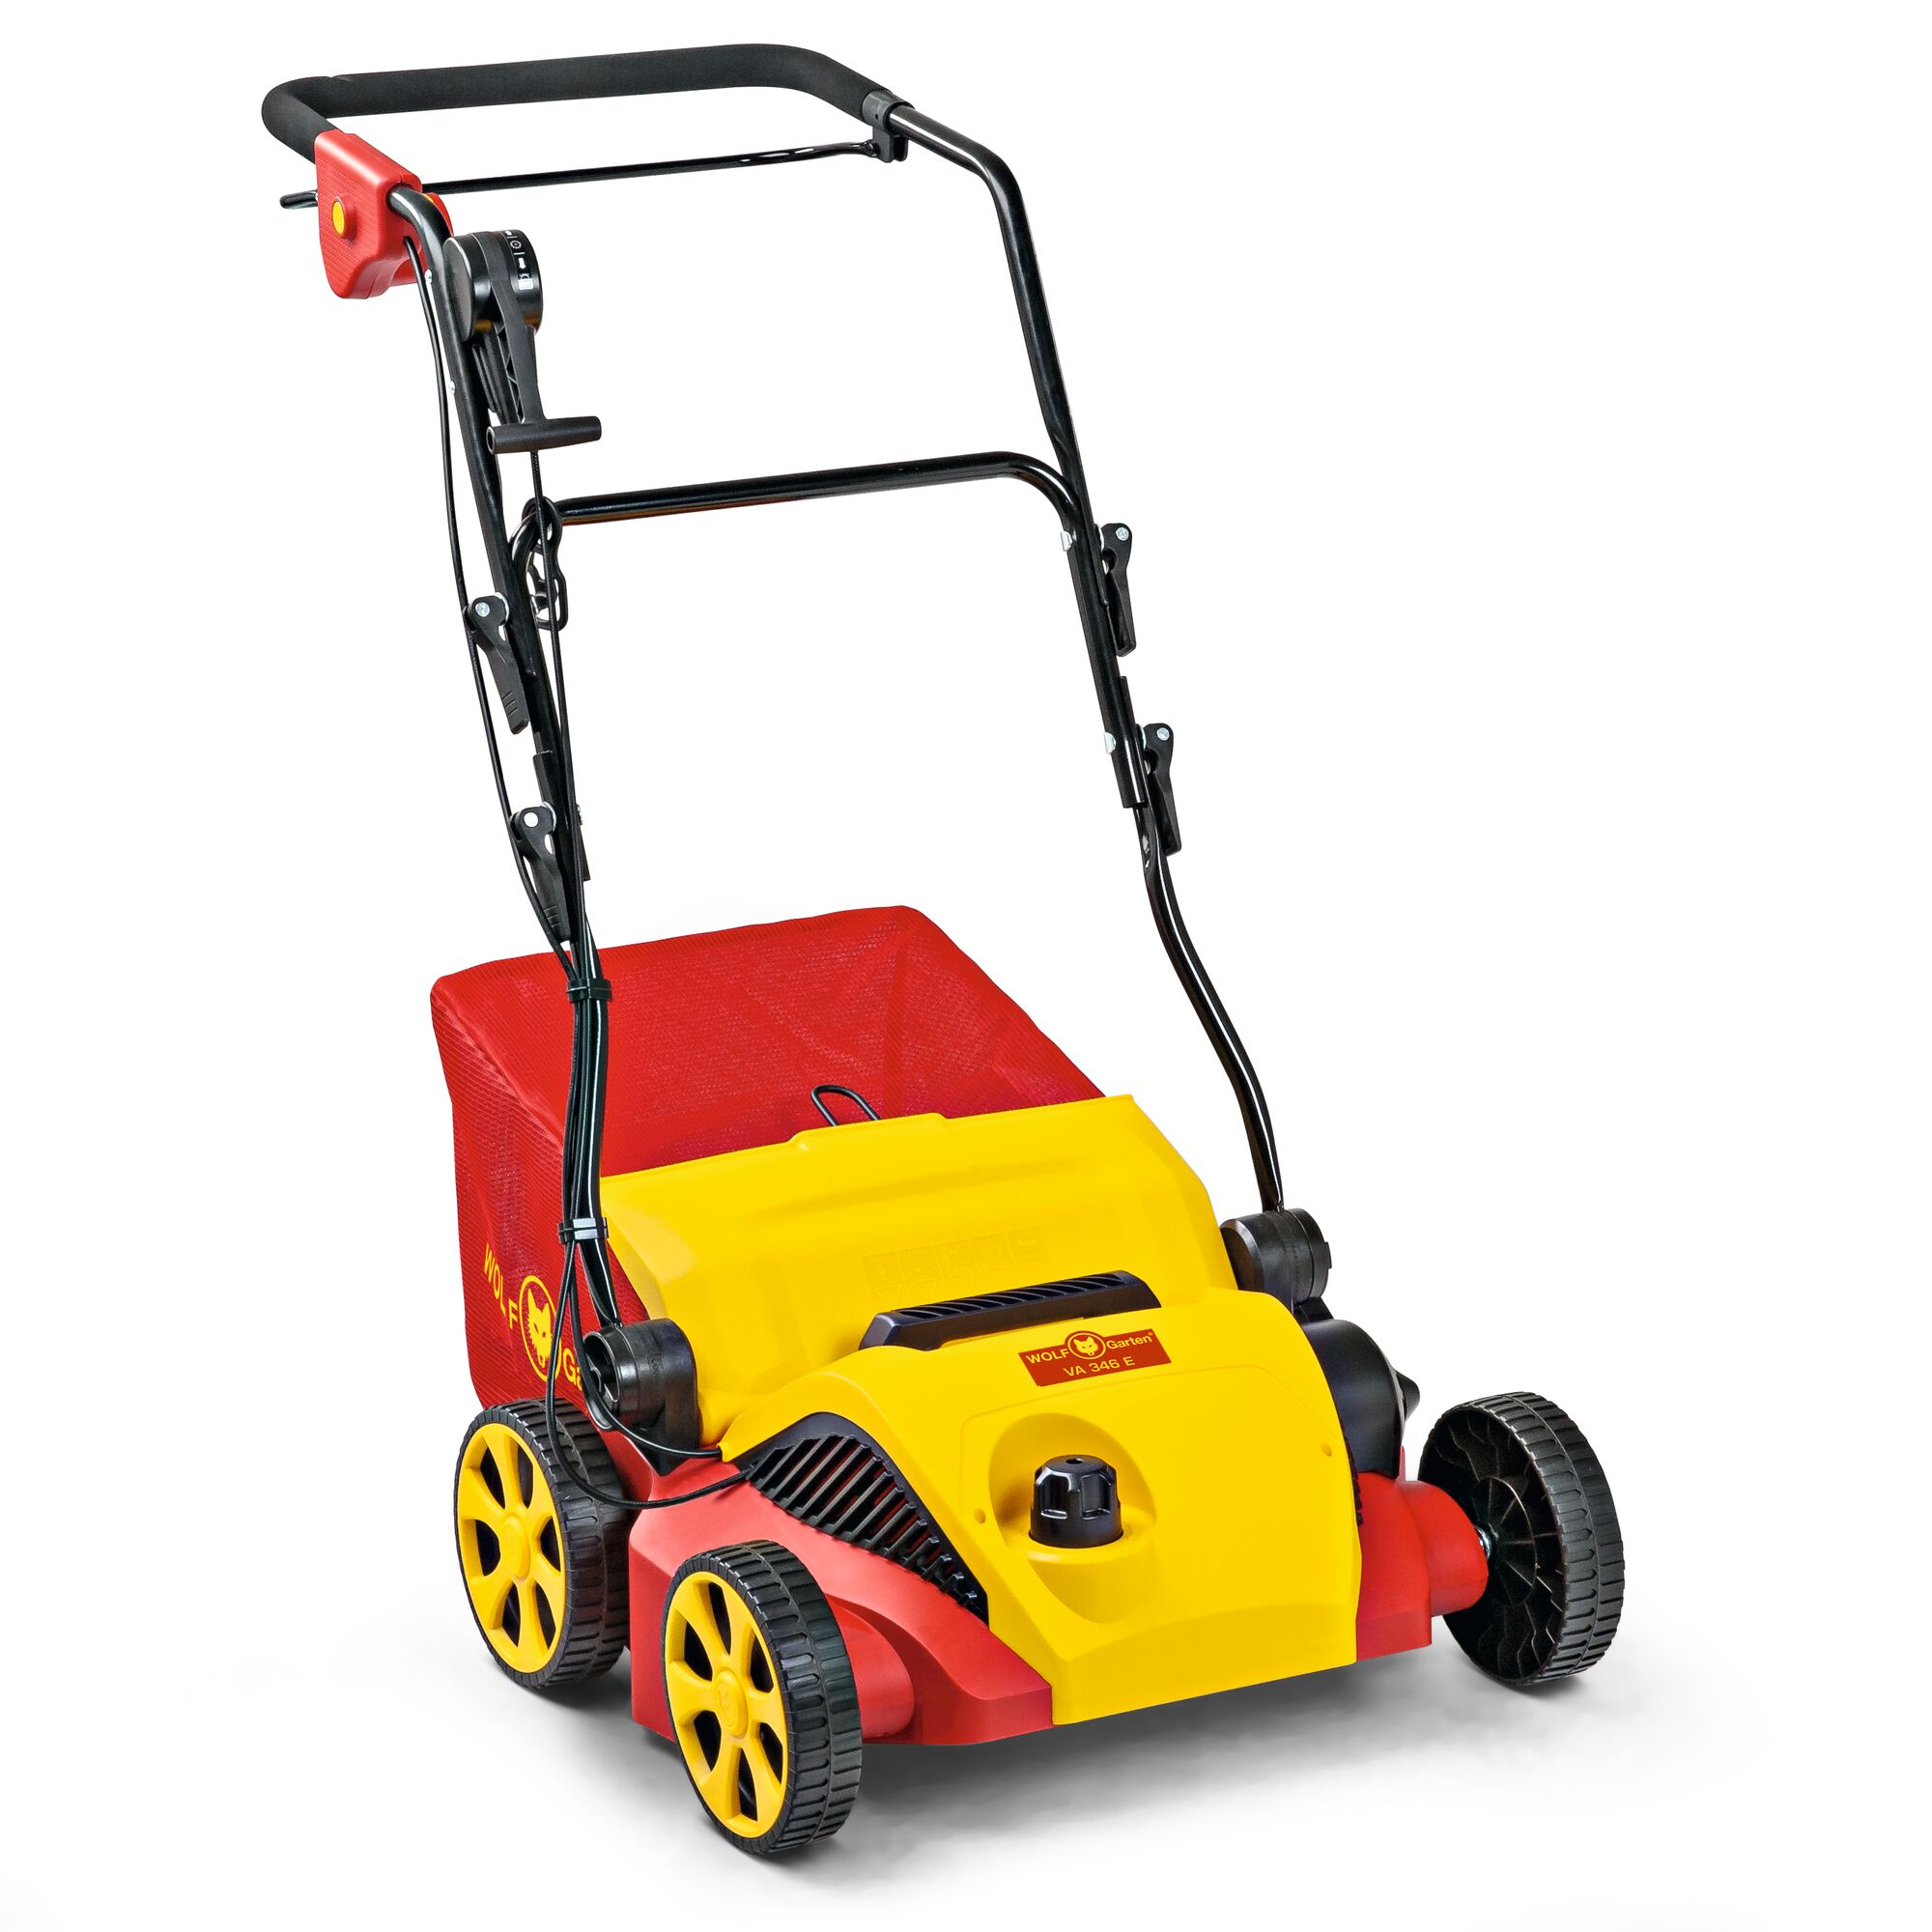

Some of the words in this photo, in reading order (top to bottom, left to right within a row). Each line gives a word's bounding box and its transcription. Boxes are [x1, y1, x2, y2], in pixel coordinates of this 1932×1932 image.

[484, 1242, 518, 1329] WOLF
[1026, 1349, 1070, 1364] WOLF
[1064, 1365, 1087, 1377] VA
[1089, 1359, 1121, 1373] 346
[1123, 1356, 1136, 1366] E
